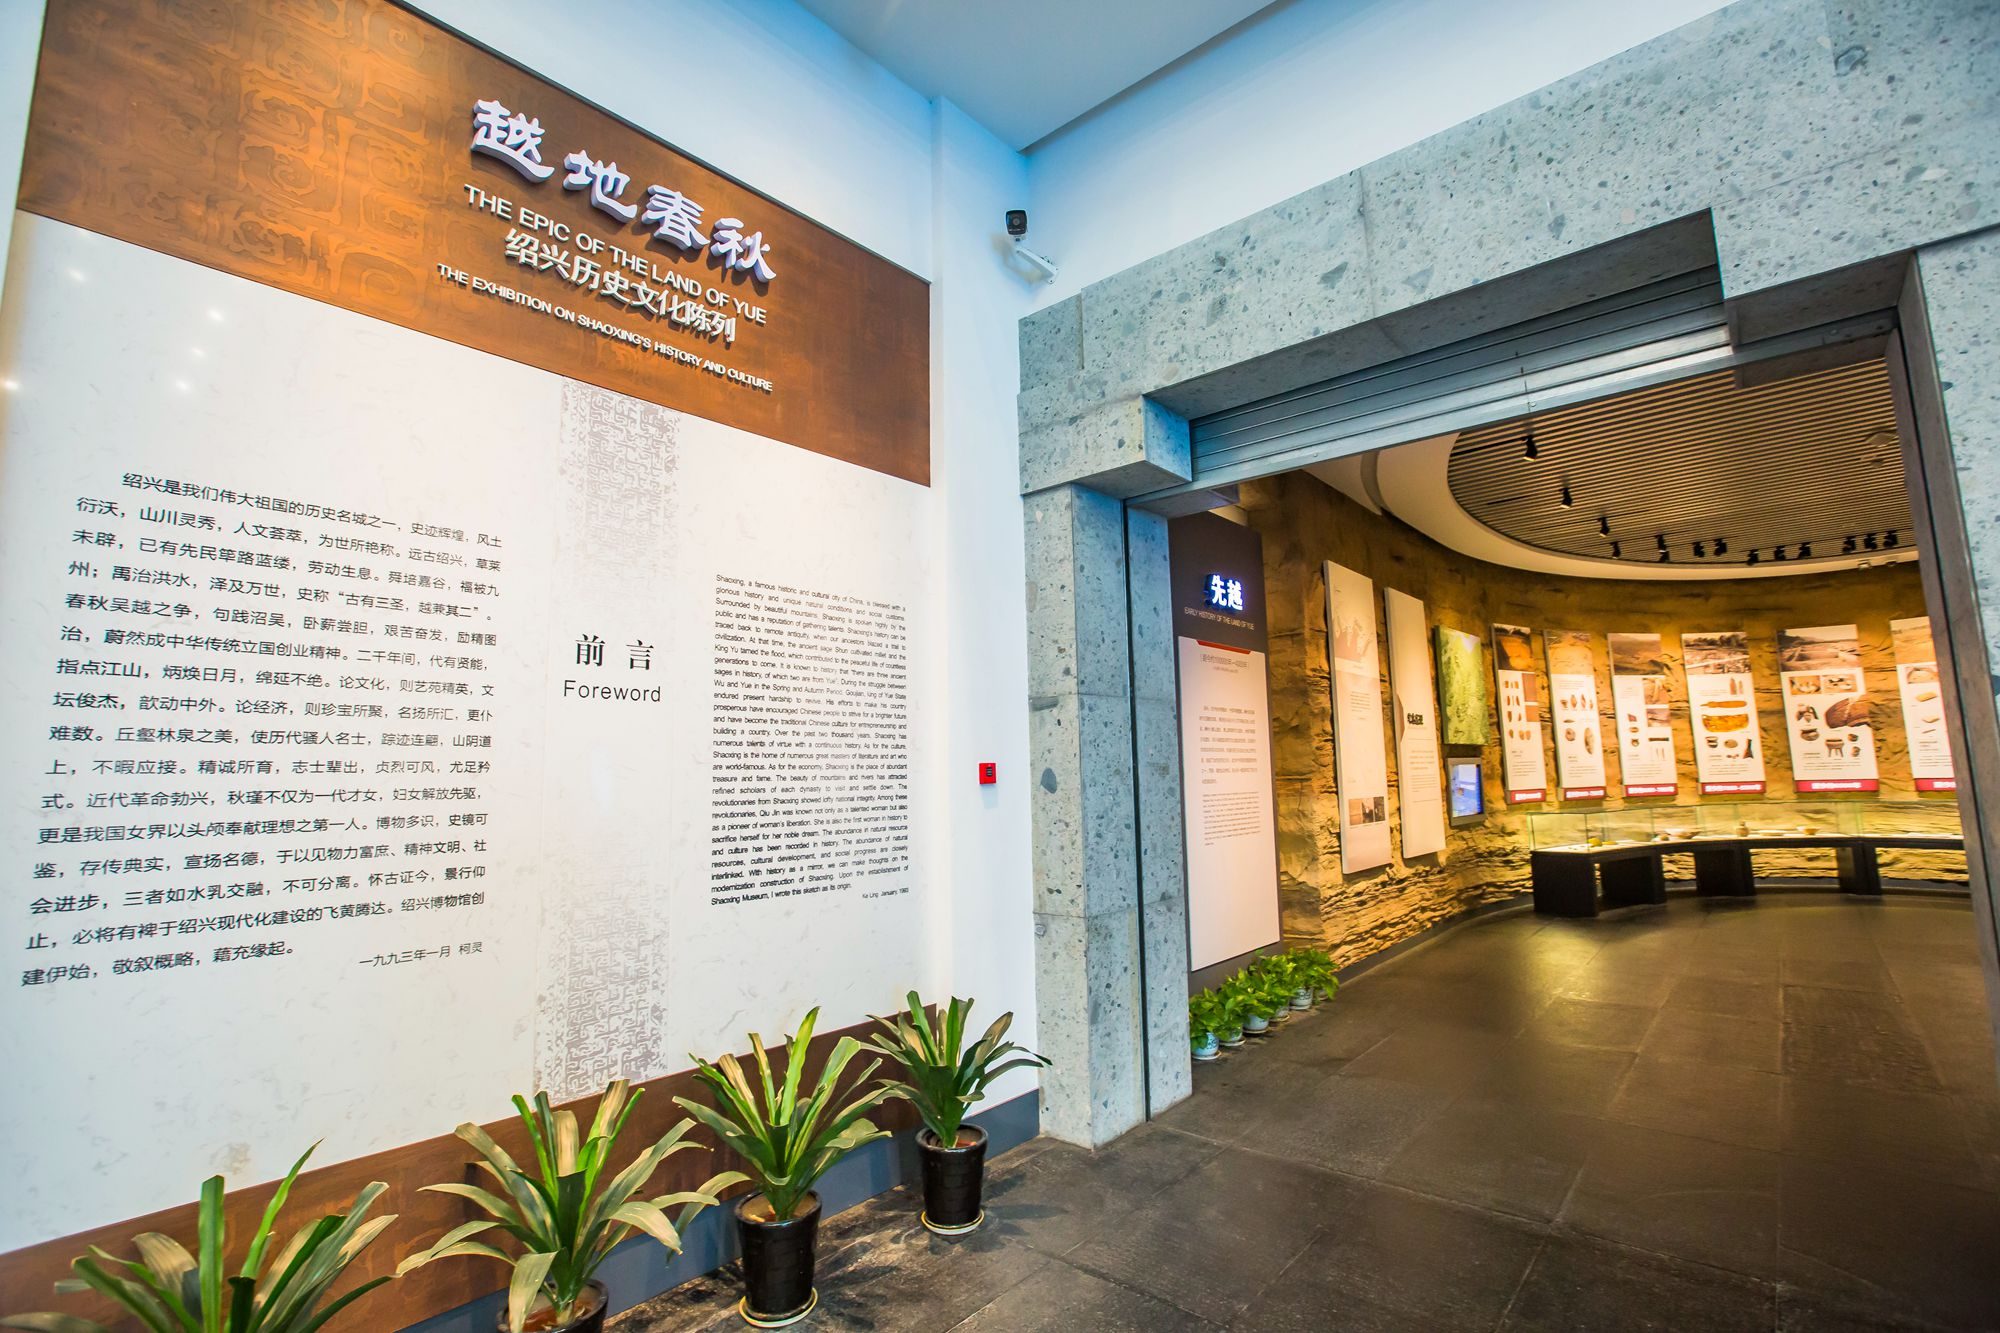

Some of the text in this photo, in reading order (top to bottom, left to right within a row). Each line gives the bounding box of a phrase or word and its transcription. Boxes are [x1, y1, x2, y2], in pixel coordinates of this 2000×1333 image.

[470, 99, 776, 283] 越地春秋
[464, 183, 767, 325] THE EPIC OF THE LAND OF YUE
[503, 227, 737, 344] 绍兴历史文化陈列
[437, 263, 774, 393] THE EXHIBITION ON SHAOXING'S HISTORY AND CULTURE
[1209, 574, 1244, 611] 先越
[563, 679, 661, 702] Foreword
